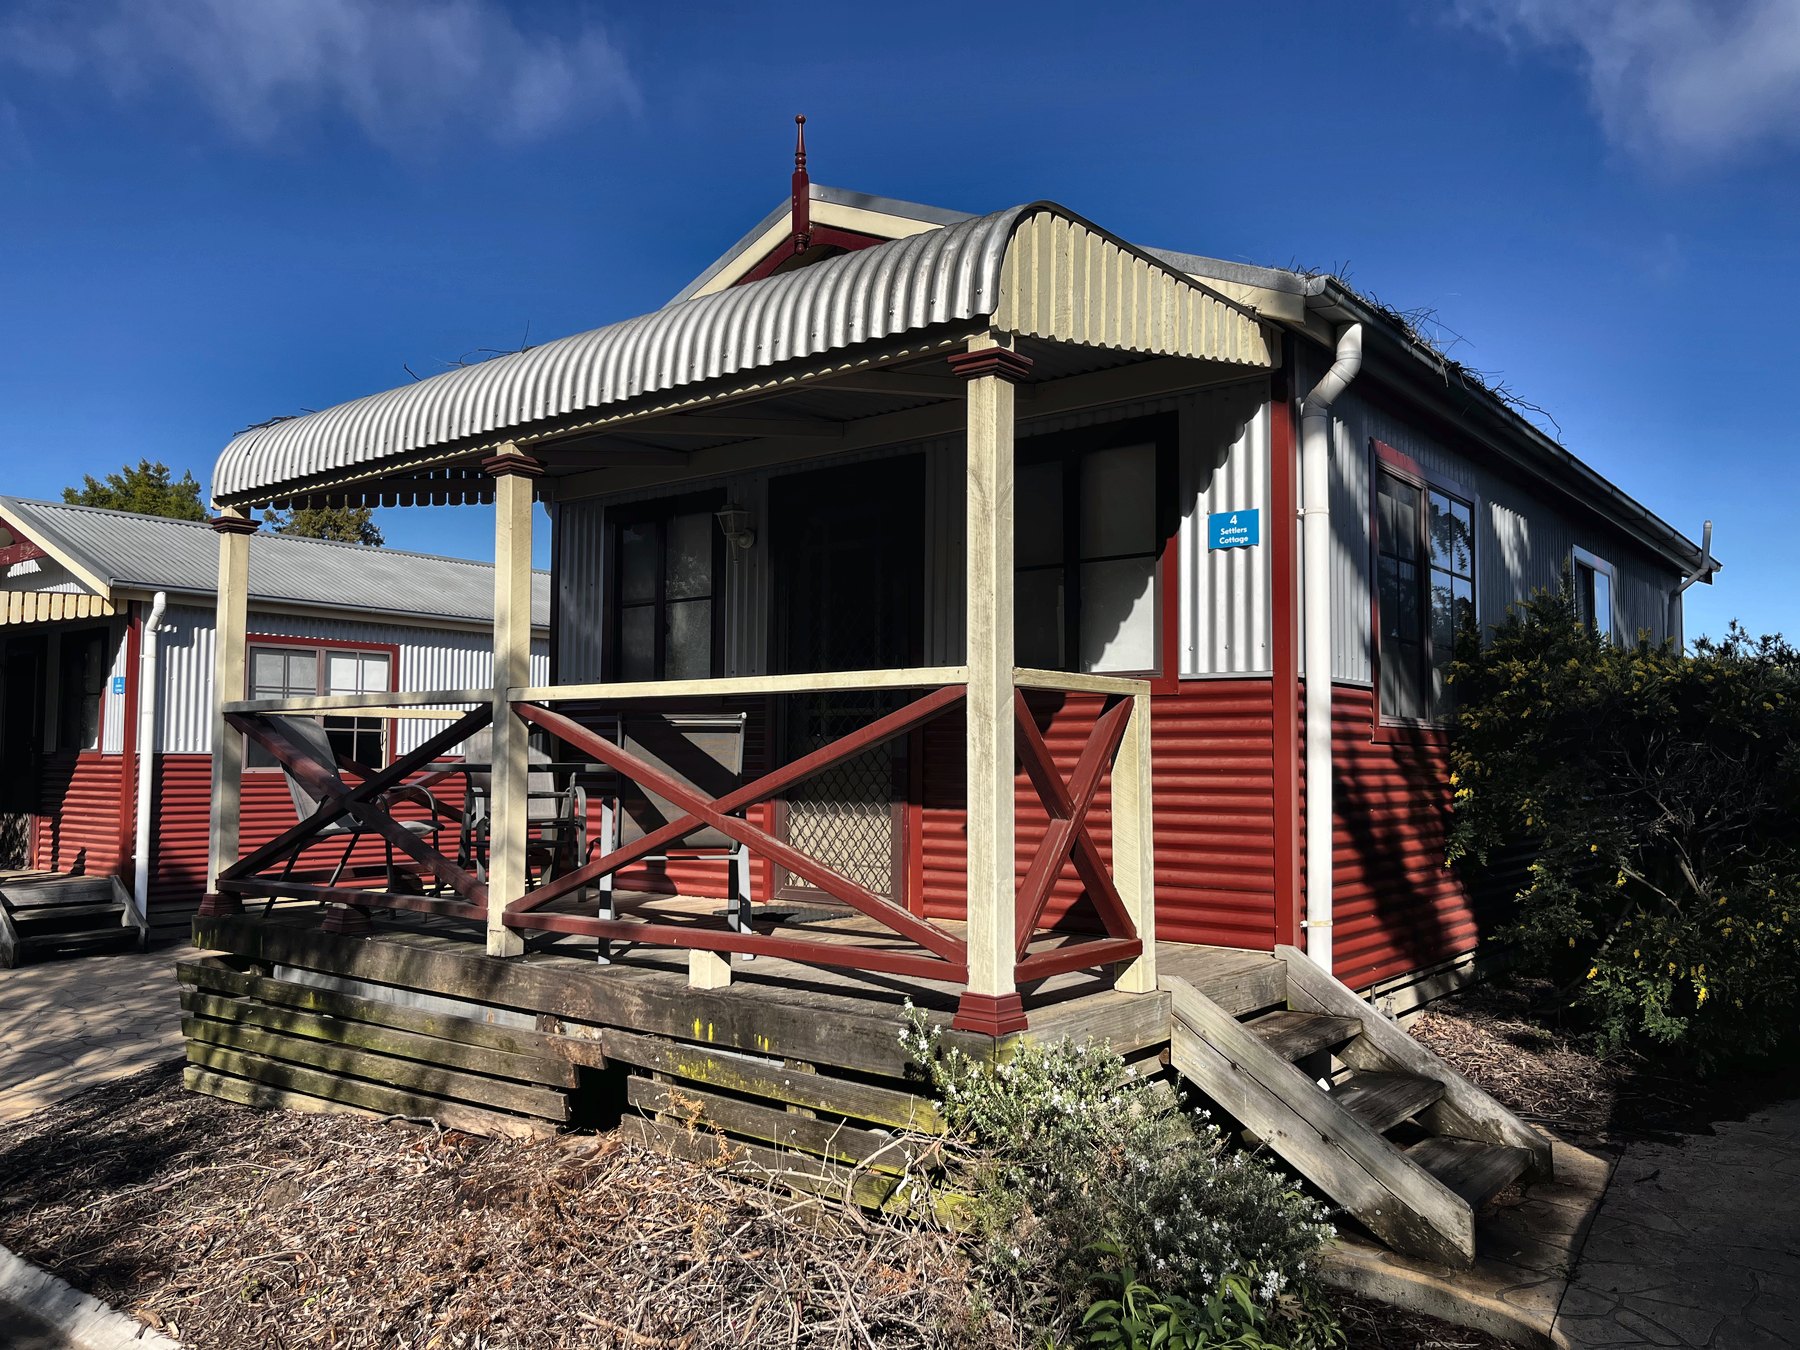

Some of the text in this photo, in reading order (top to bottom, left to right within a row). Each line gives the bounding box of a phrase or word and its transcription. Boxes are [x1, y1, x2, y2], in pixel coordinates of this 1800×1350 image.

[1229, 514, 1238, 525] 4
[1220, 526, 1248, 536] Settlers
[1219, 536, 1249, 544] Cottage
